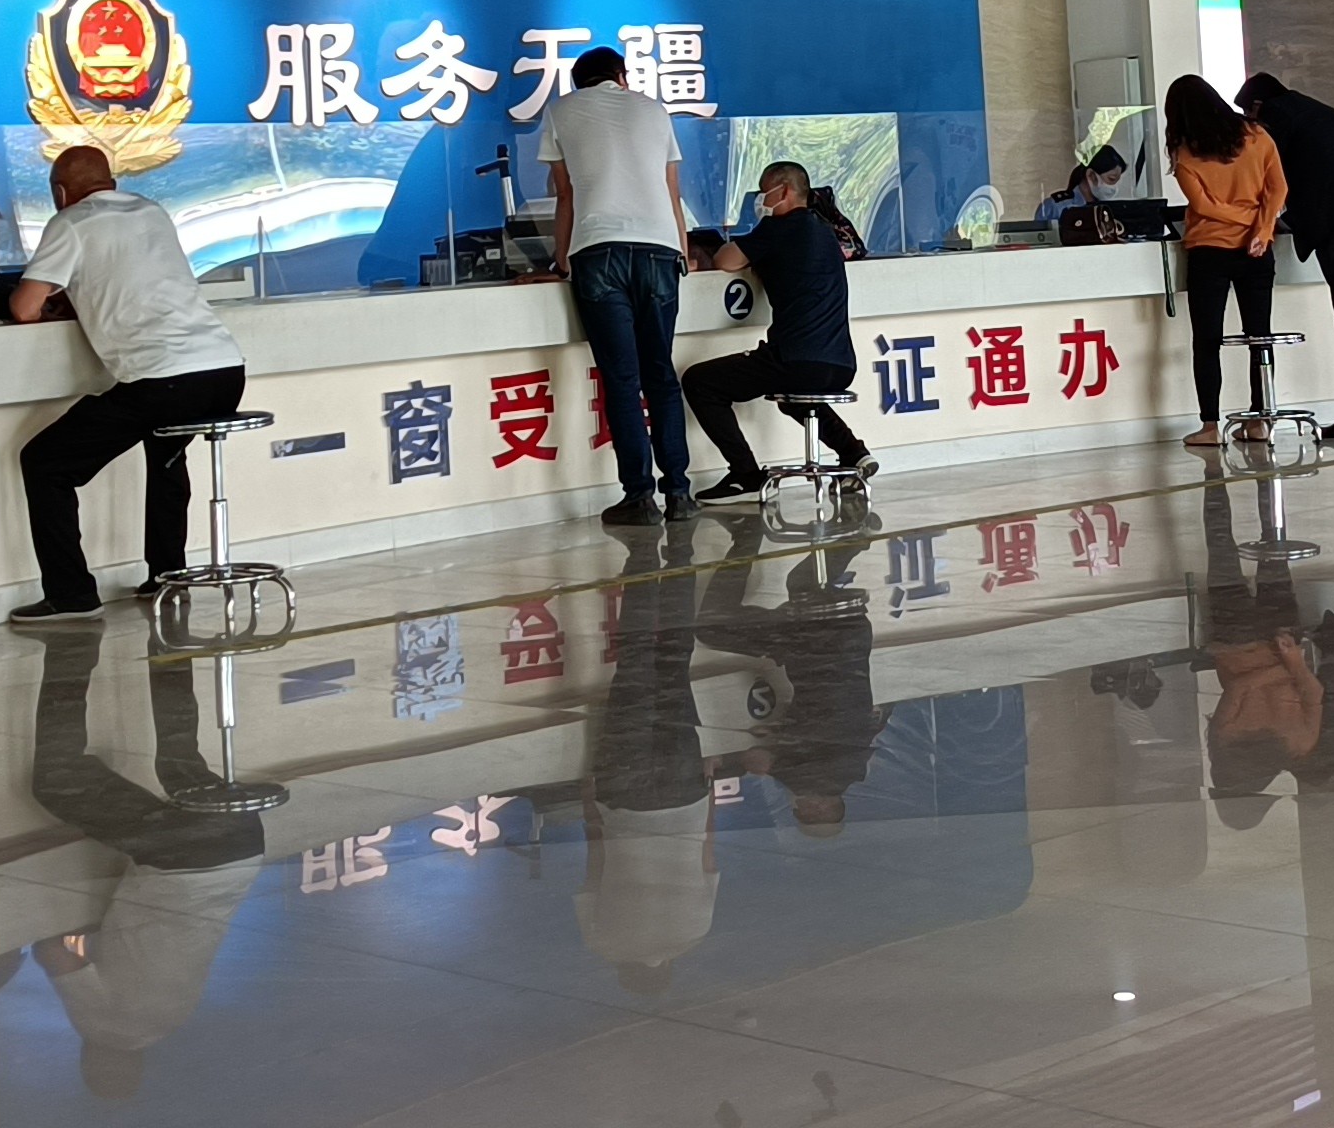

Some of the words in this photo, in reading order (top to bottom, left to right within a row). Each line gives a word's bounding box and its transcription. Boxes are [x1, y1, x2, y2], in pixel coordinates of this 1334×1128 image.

[248, 20, 719, 126] 服务无疆
[729, 283, 749, 315] 2
[873, 318, 1120, 415] 证通办
